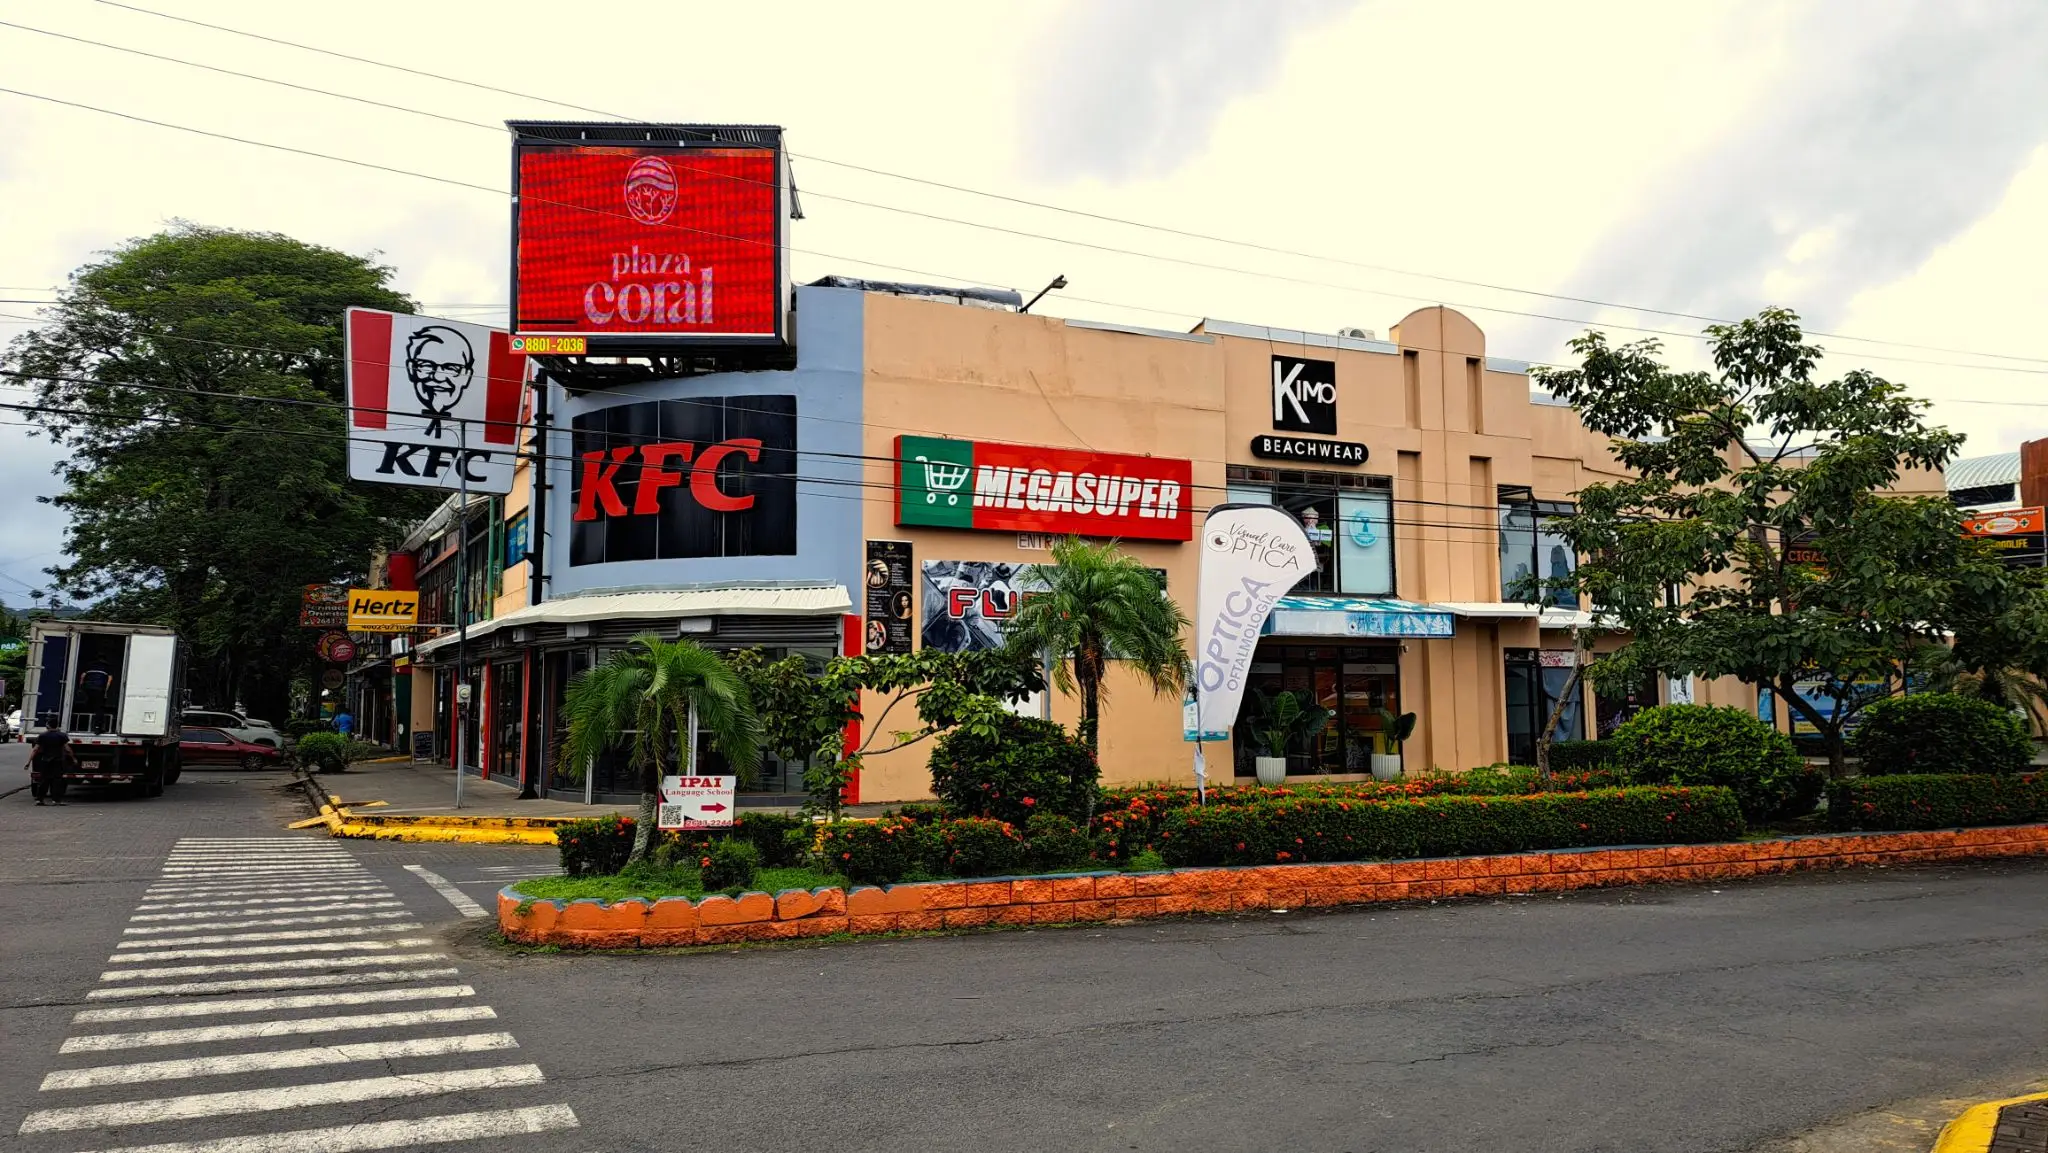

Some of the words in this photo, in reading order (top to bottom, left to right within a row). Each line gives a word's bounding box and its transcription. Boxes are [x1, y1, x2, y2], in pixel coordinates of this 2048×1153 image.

[612, 245, 690, 281] plaza
[584, 266, 713, 325] coral
[525, 337, 584, 352] 8801-2036
[1273, 360, 1337, 424] KIMO
[375, 441, 492, 482] KFC
[1263, 438, 1363, 460] BEACHWEAR
[572, 438, 763, 522] KFC
[973, 464, 1181, 519] MEGASUPER
[1229, 522, 1268, 544] Visual
[1269, 535, 1297, 553] Care
[352, 598, 416, 615] Hertz
[1199, 576, 1271, 692] OPTICA
[665, 788, 705, 797] Language
[706, 788, 733, 796] School
[679, 777, 722, 788] IPAI
